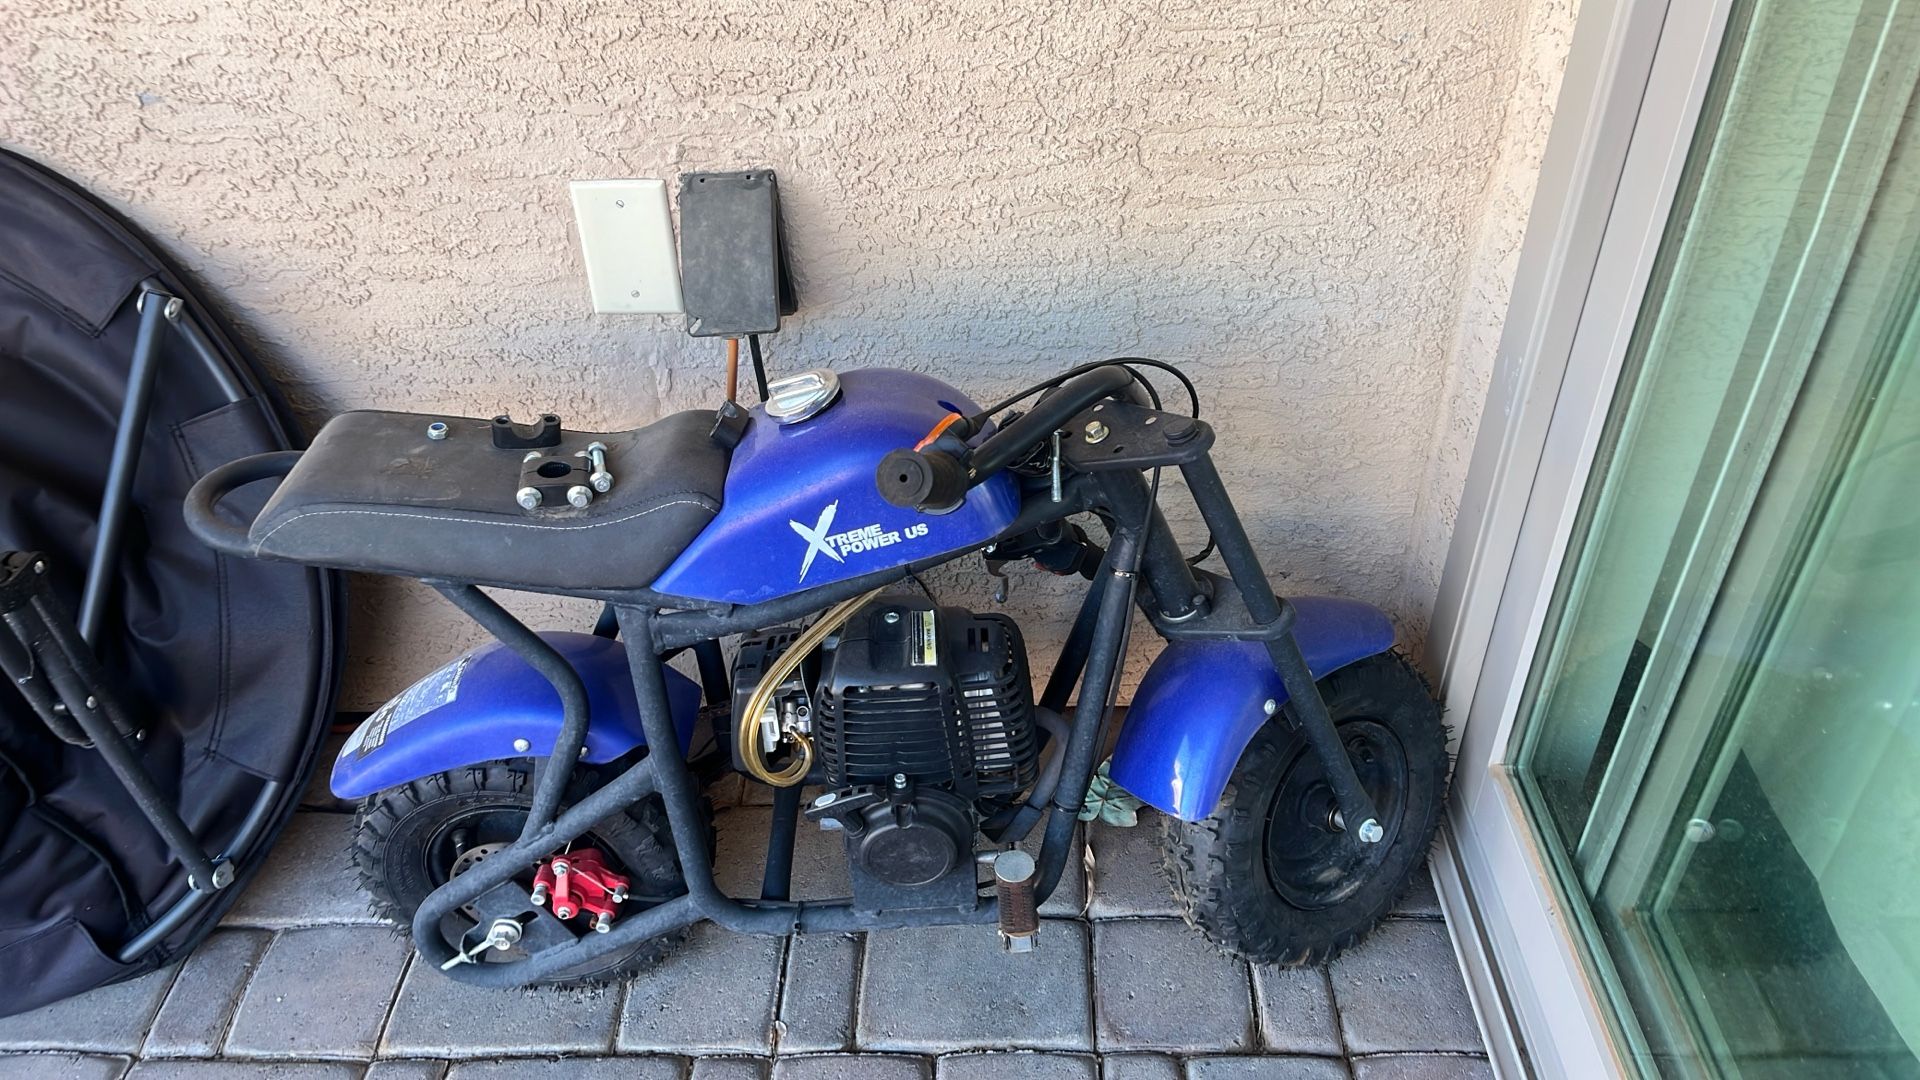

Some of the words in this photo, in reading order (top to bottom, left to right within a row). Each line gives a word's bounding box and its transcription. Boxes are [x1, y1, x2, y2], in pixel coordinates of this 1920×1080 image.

[789, 499, 882, 584] XTREME
[840, 531, 902, 557] POWER
[904, 523, 929, 539] US
